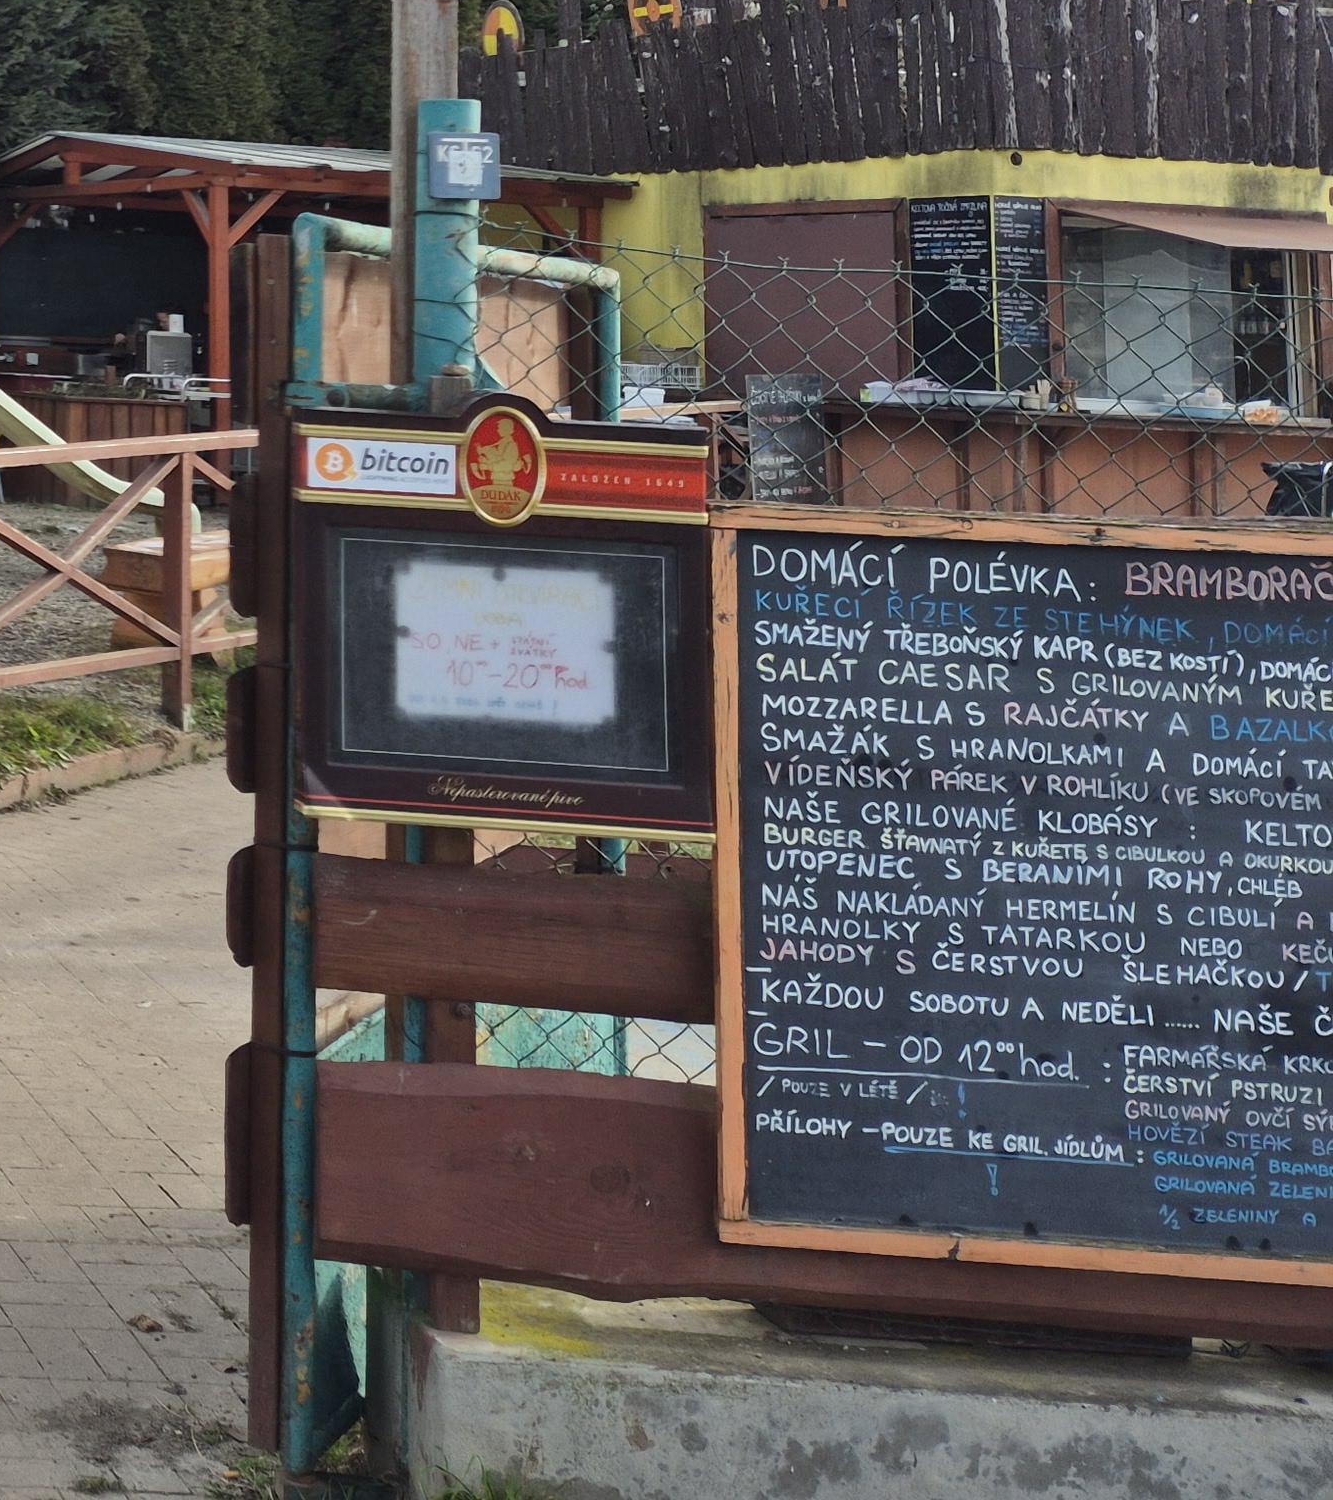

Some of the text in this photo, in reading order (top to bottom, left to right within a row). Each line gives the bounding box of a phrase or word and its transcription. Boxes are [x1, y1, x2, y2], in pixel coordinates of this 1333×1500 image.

[361, 447, 450, 475] bitcoin
[752, 540, 907, 588] DOMÁCÍ
[755, 584, 874, 619] KUŘECÍ
[888, 588, 977, 629] ŘÍZEK
[994, 606, 1029, 629] ZE
[754, 618, 874, 653] SMAŽENÝ
[883, 622, 1025, 660] TŘEBOŇSKÝ
[1034, 635, 1099, 663] KAPR
[1104, 643, 1163, 672] (BEZ
[1260, 656, 1333, 684] DOMÁC
[756, 652, 858, 684] SALÁT
[878, 658, 1012, 694] CAESAR
[1036, 668, 1055, 695] S
[1071, 671, 1243, 707] GRILOVANÝM
[761, 693, 953, 726] MOZZARELLA
[965, 701, 986, 728] S
[1003, 697, 1149, 733] RAJČÁTKY
[1167, 711, 1190, 737] A
[760, 722, 1333, 781] SMAŽÁK S HRANOLKAMI A DOMÁCÍ TA
[764, 754, 1322, 812] VÍDEŇSKÝ PÁREK V ROHLÍKU (VE SKOPOVÉM
[764, 790, 842, 825] NAŠE
[861, 797, 1017, 832] GRILOVANÉ
[1038, 805, 1158, 839] KLOBÁSY
[764, 822, 866, 850] BURGER
[880, 826, 982, 857] ŠŤAVNATÝ
[1011, 836, 1087, 861] KUŘETE
[1097, 845, 1110, 861] S
[1116, 845, 1206, 865] CIBULKOU
[1219, 851, 1233, 868] A
[766, 849, 916, 881] UTOPENEC
[944, 857, 963, 881] S
[983, 857, 1124, 888] BERANÍMI
[1237, 872, 1304, 899] CHLÉB
[761, 874, 819, 911] NÁŠ
[836, 882, 987, 918] NAKLÁDANÝ
[1006, 890, 1137, 925] HERMELÍN
[1156, 903, 1174, 926] S
[1187, 897, 1283, 931] CIBULÍ
[1296, 911, 1315, 931] A
[762, 913, 921, 945] HRANOLKY
[947, 922, 965, 946] S
[981, 925, 1147, 955] TATARKOU
[1180, 936, 1243, 960] NEBO
[759, 938, 1285, 989] JAHODY S ČERSTVOU ŠLEHAČKOU
[761, 972, 1294, 1036] KAŽDOU SOBOTU A NEDĚLI NAŠE
[753, 1022, 851, 1059] GRIL
[900, 1035, 943, 1064] OD
[1124, 1044, 1274, 1073] FARMÁŘSKÁ
[840, 1083, 852, 1097] V
[859, 1079, 899, 1100] LÉTĚ
[1123, 1068, 1323, 1106] ČERSTVÍ PSTRUZI
[756, 1108, 1124, 1162] PŘÍLOHY POUZE KE GRIL. JÍDLŮM
[1124, 1100, 1232, 1124] GRILOVANÝ
[1245, 1106, 1295, 1129] OVČÍ
[1128, 1122, 1209, 1146] HOVĚZÍ
[1225, 1131, 1293, 1152] STEAK
[1153, 1151, 1260, 1172] GRILOVANÁ
[1154, 1174, 1258, 1196] GRILOVANÁ
[1194, 1208, 1280, 1225] ZELENINY
[1302, 1212, 1317, 1228] A
